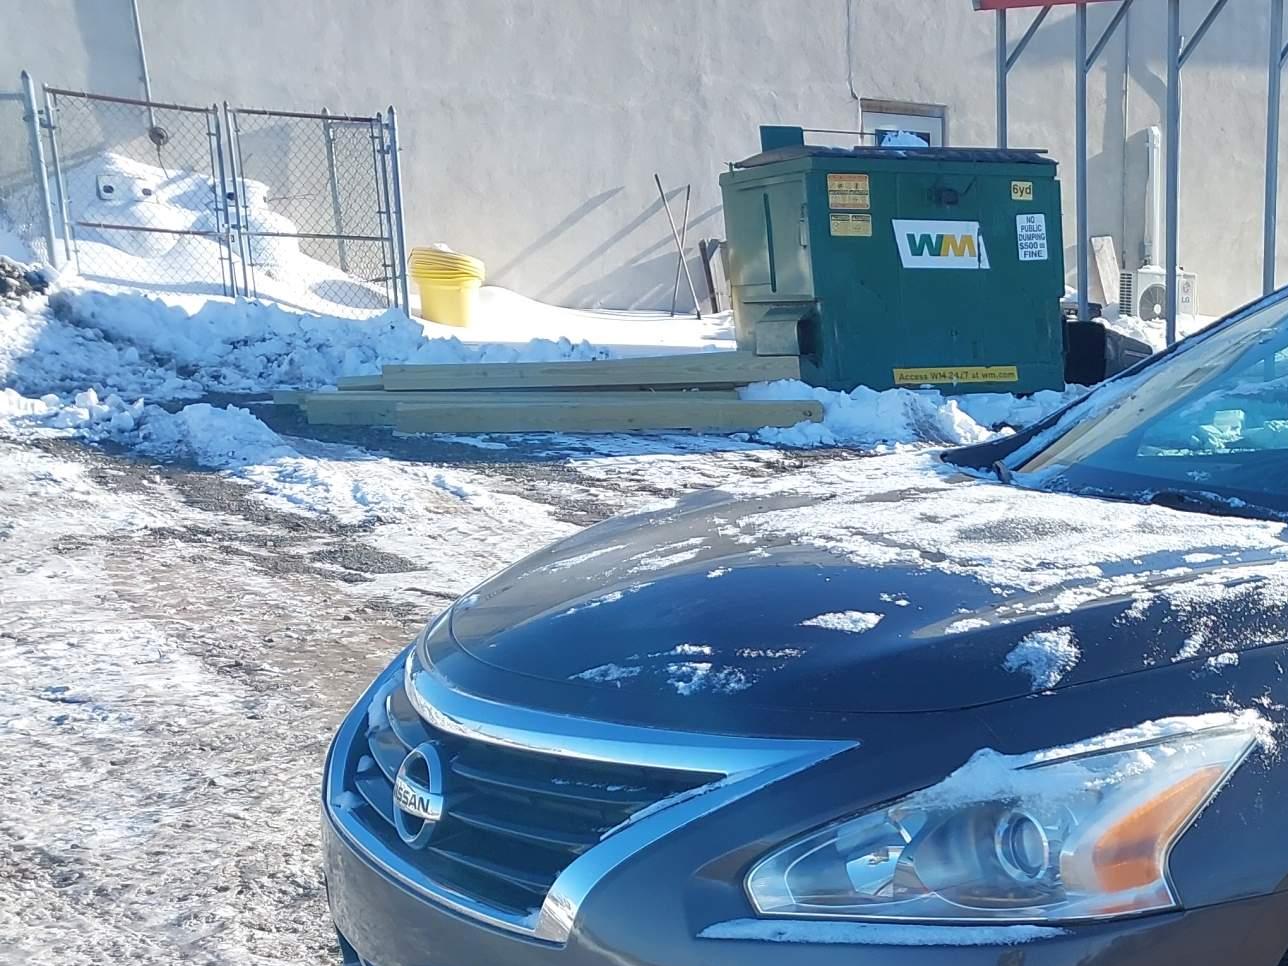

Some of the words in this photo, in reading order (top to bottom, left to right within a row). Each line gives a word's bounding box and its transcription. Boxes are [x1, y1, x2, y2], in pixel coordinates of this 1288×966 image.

[1012, 184, 1032, 197] 6yd
[1018, 233, 1046, 241] DUMPING
[906, 233, 977, 257] WM
[1023, 250, 1044, 258] FINE
[899, 373, 927, 381] Access
[394, 783, 430, 813] ISSAN
